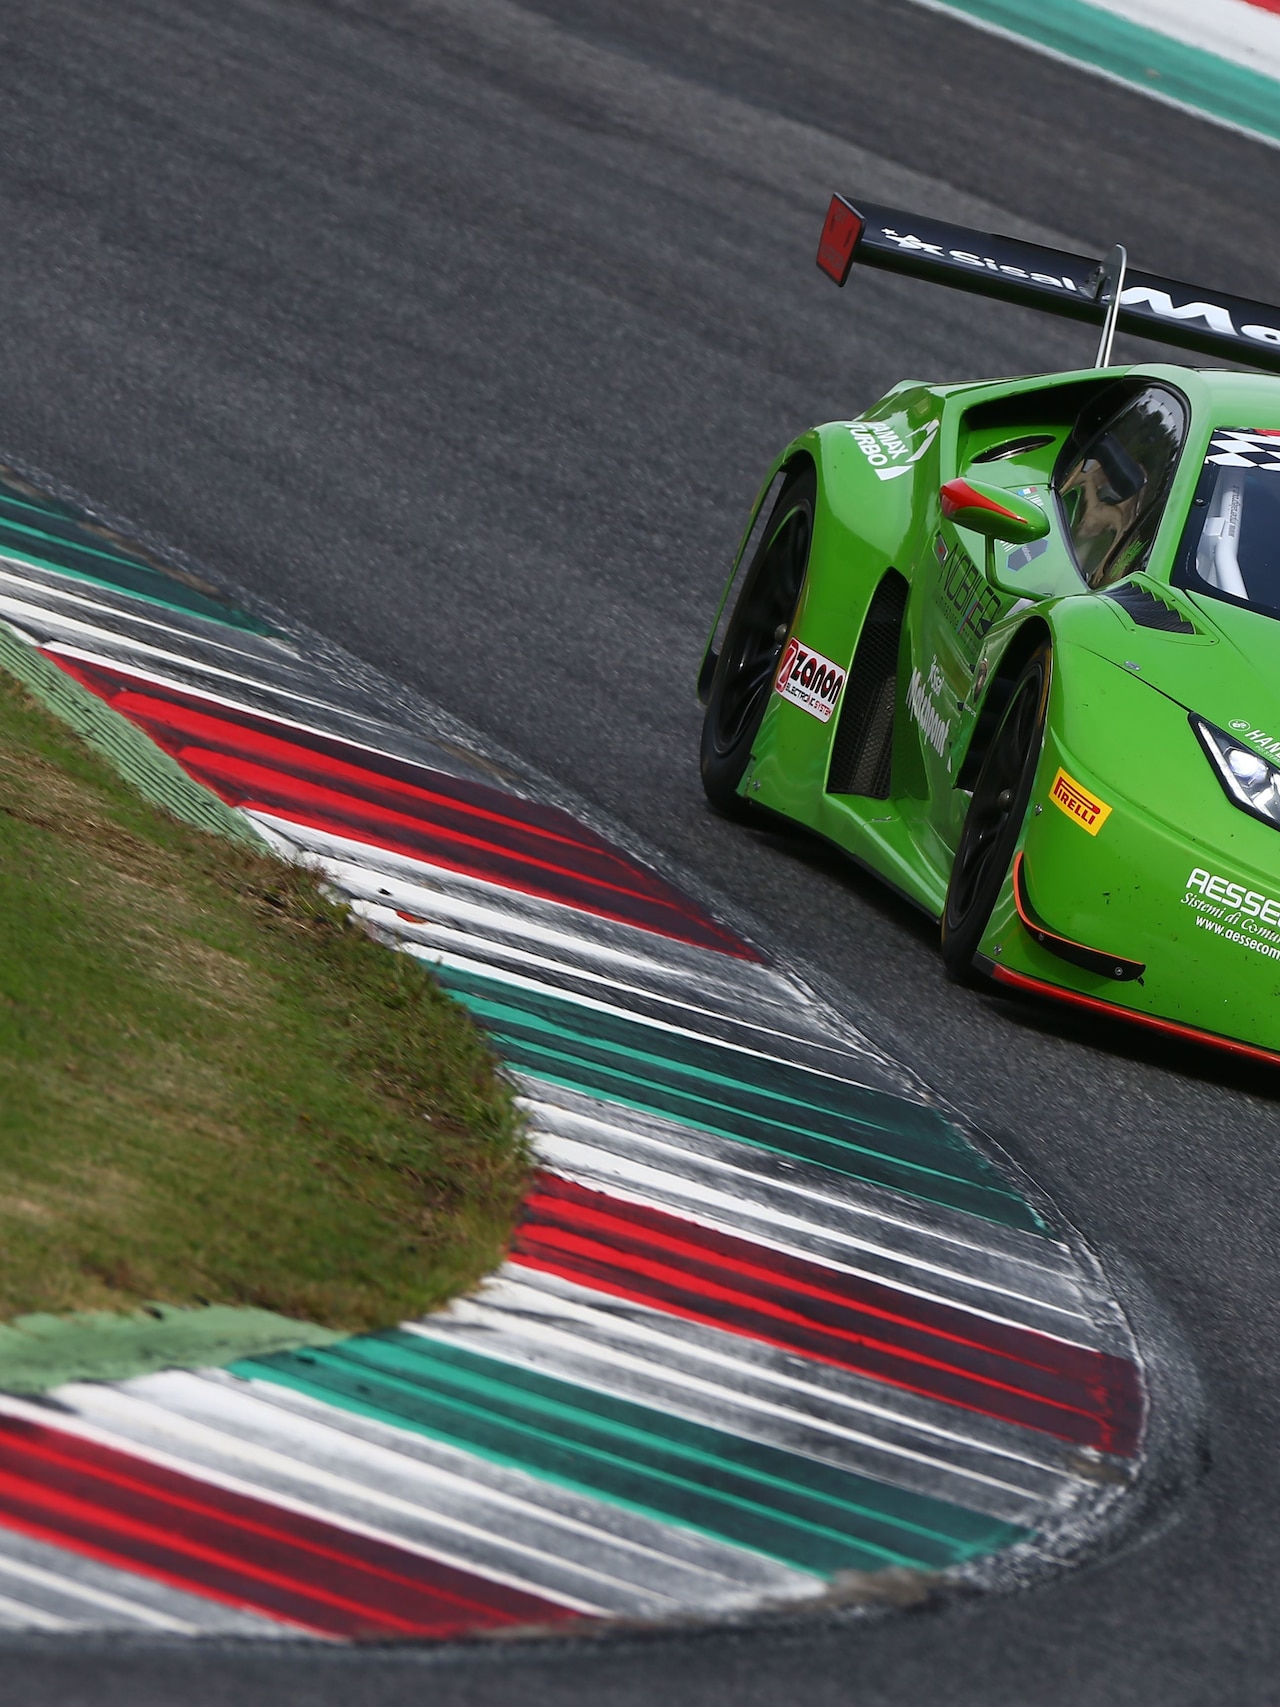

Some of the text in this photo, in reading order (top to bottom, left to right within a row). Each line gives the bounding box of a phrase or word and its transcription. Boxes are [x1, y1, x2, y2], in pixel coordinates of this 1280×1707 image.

[949, 249, 1078, 292] Sisal
[844, 423, 888, 466] TURBO
[1053, 776, 1100, 825] PIRELLI
[1180, 892, 1227, 919] Sistemi
[1224, 911, 1242, 925] di
